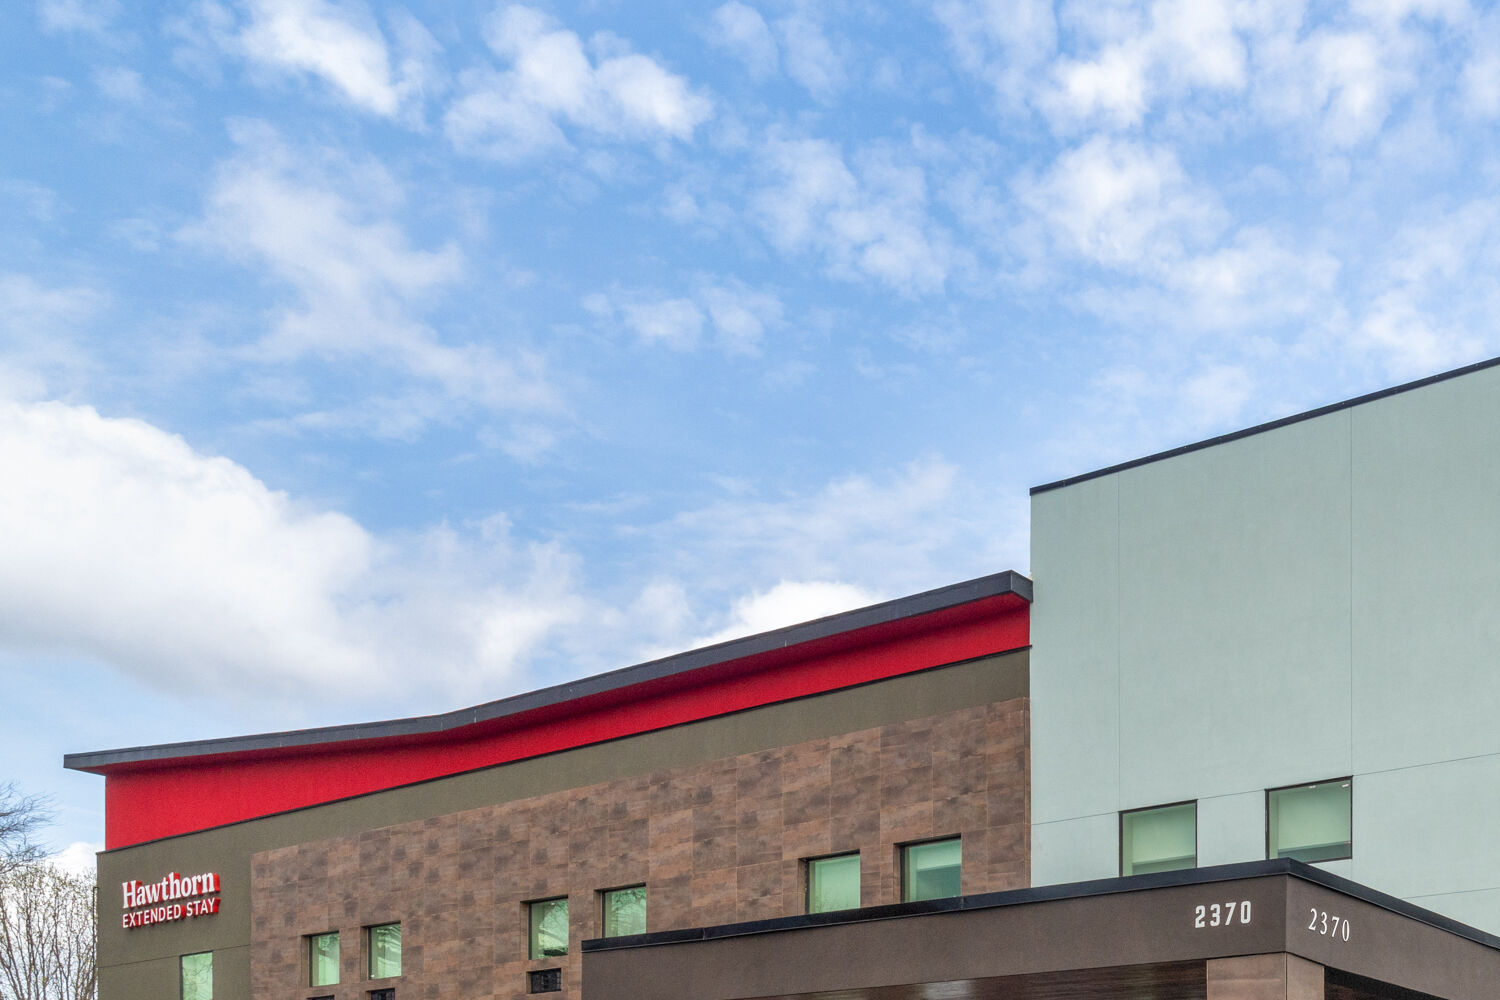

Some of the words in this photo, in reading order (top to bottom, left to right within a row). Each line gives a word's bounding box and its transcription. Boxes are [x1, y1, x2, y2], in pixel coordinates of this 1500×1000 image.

[122, 871, 218, 909] Hawthorn
[122, 904, 182, 928] EXTENDED
[186, 897, 217, 917] STAY
[1194, 900, 1251, 929] 2370
[1308, 907, 1350, 942] 2370
